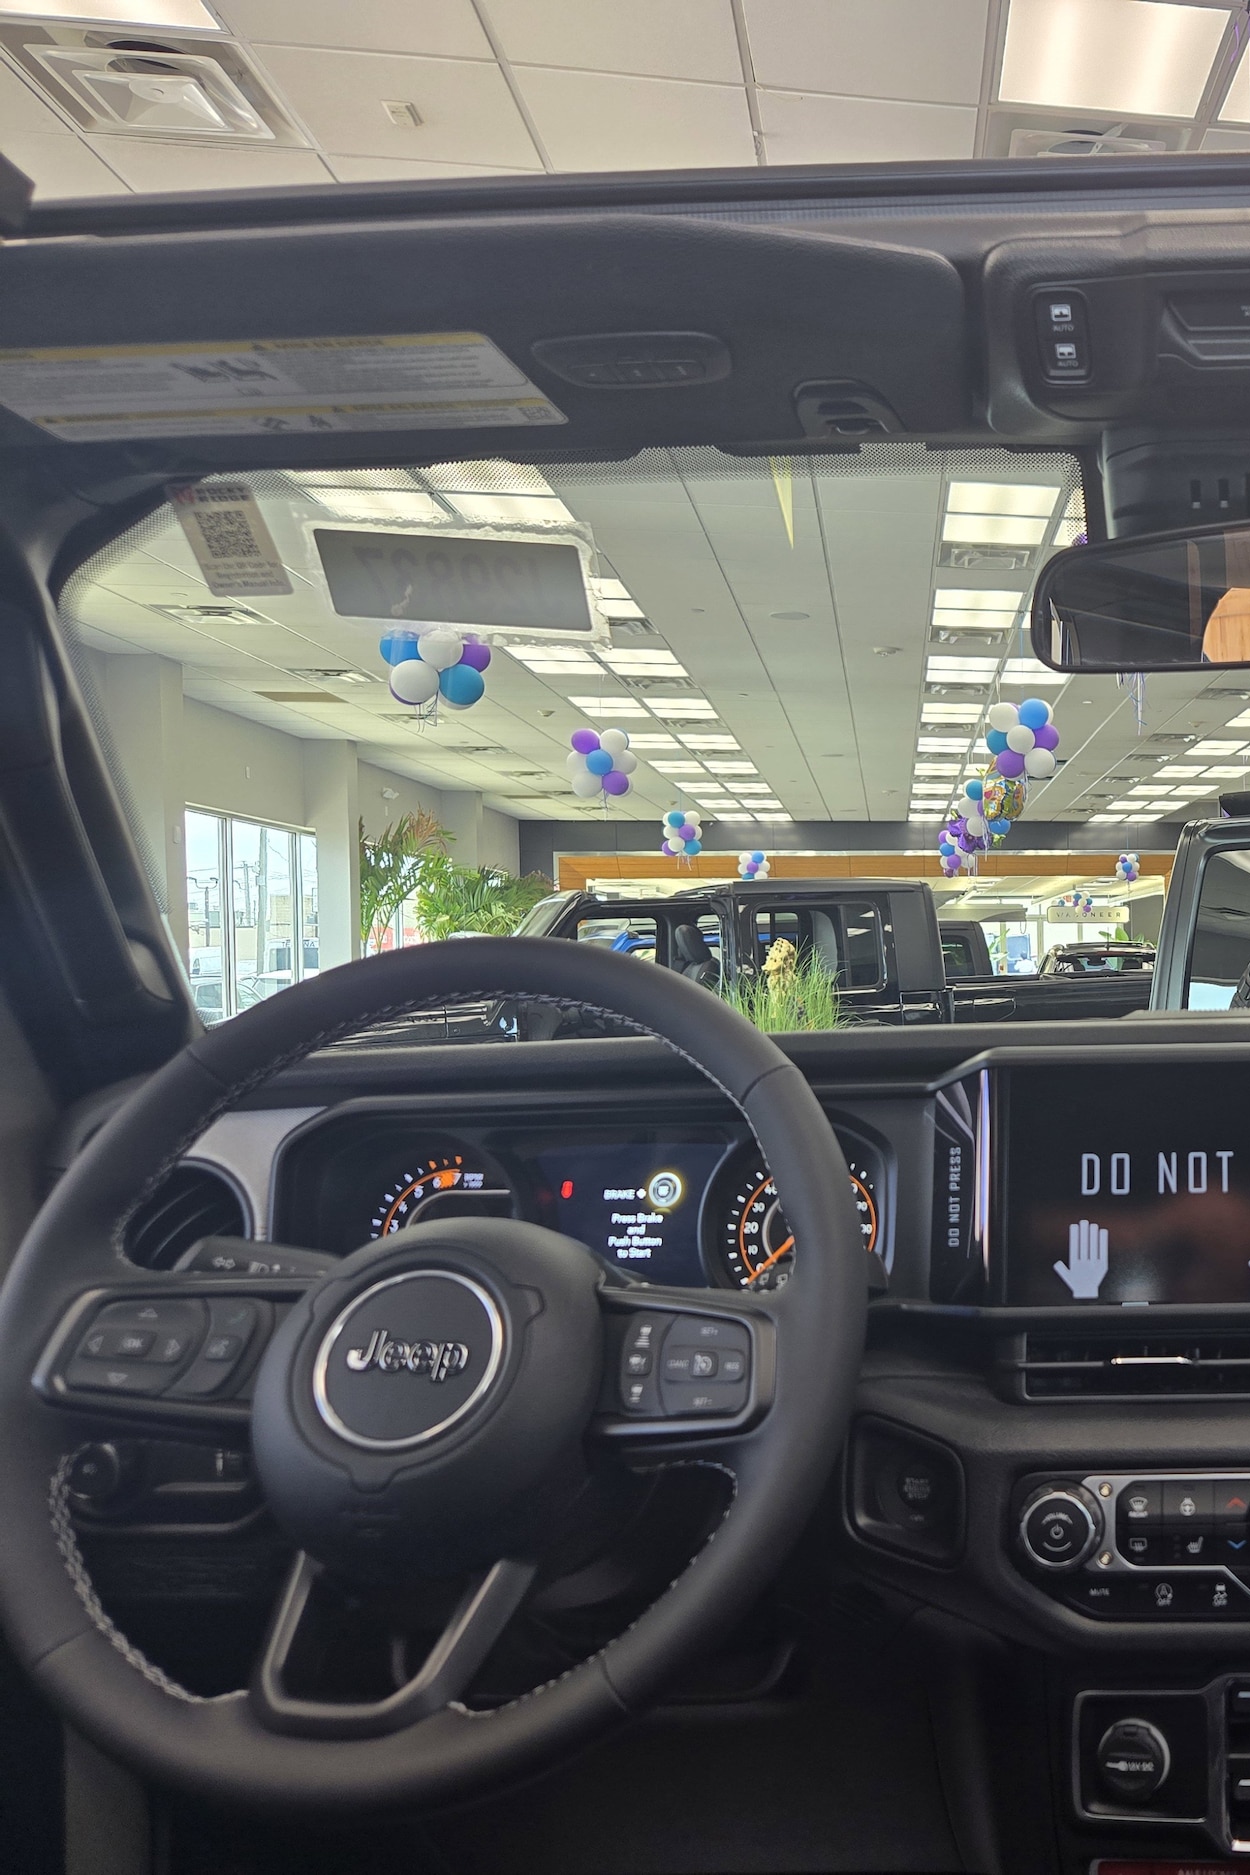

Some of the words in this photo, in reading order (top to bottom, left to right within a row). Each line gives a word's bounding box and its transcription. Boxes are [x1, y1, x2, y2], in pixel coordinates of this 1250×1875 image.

[1053, 324, 1075, 332] AUTO
[1057, 360, 1080, 368] AUTO
[948, 1147, 962, 1192] PRESS
[1081, 1152, 1130, 1194] DO
[1158, 1150, 1234, 1194] NOT
[433, 1176, 442, 1189] 6
[450, 1172, 462, 1187] 7
[414, 1185, 425, 1199] 5
[604, 1189, 635, 1200] BRAKE
[399, 1201, 408, 1214] 4
[752, 1202, 766, 1213] 30
[948, 1196, 961, 1224] NOT
[611, 1213, 636, 1224] Press
[637, 1212, 663, 1224] Brake
[390, 1219, 399, 1233] 3
[627, 1224, 646, 1235] and
[744, 1221, 759, 1234] 20
[608, 1235, 631, 1247] Push
[632, 1235, 663, 1247] Button
[947, 1227, 960, 1248] DO
[617, 1248, 628, 1259] to
[629, 1247, 652, 1259] Start
[748, 1244, 760, 1256] 10
[346, 1329, 469, 1381] Jeep
[1090, 1588, 1110, 1596] MUTE
[1157, 1599, 1171, 1607] OFF
[1213, 1599, 1229, 1607] OFF
